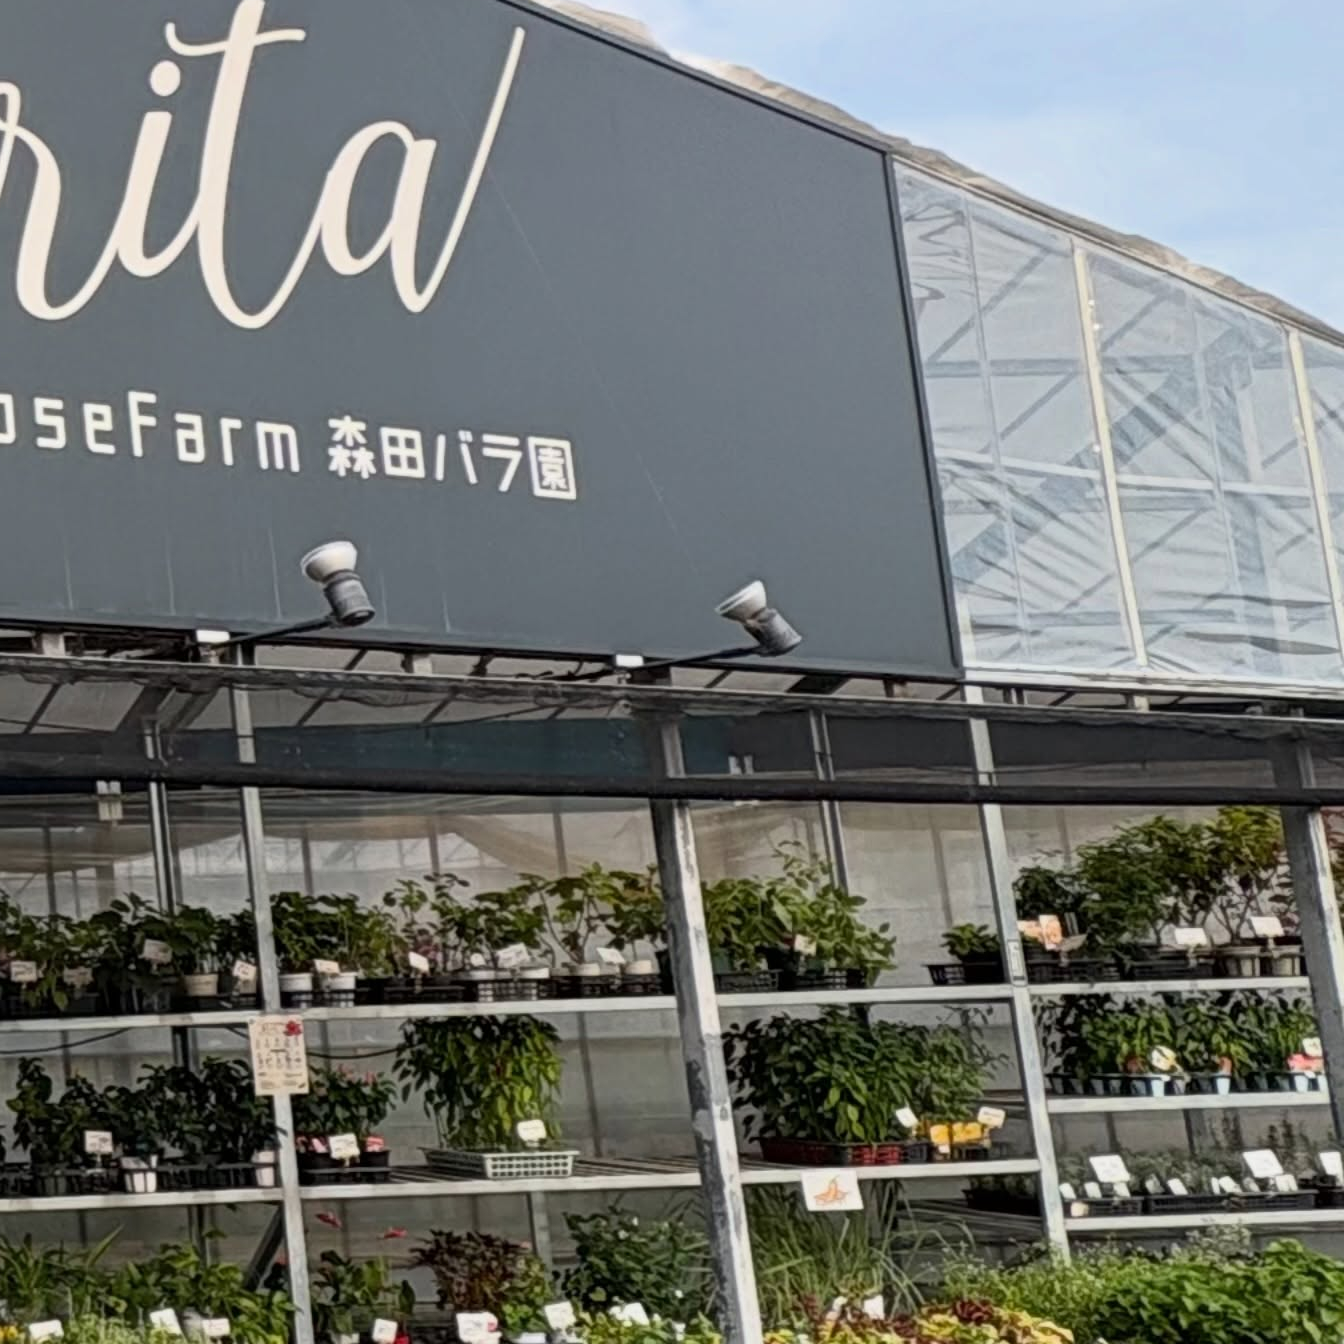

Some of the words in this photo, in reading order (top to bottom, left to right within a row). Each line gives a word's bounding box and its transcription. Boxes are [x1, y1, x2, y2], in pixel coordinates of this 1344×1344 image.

[326, 414, 578, 501] 森田バラ園
